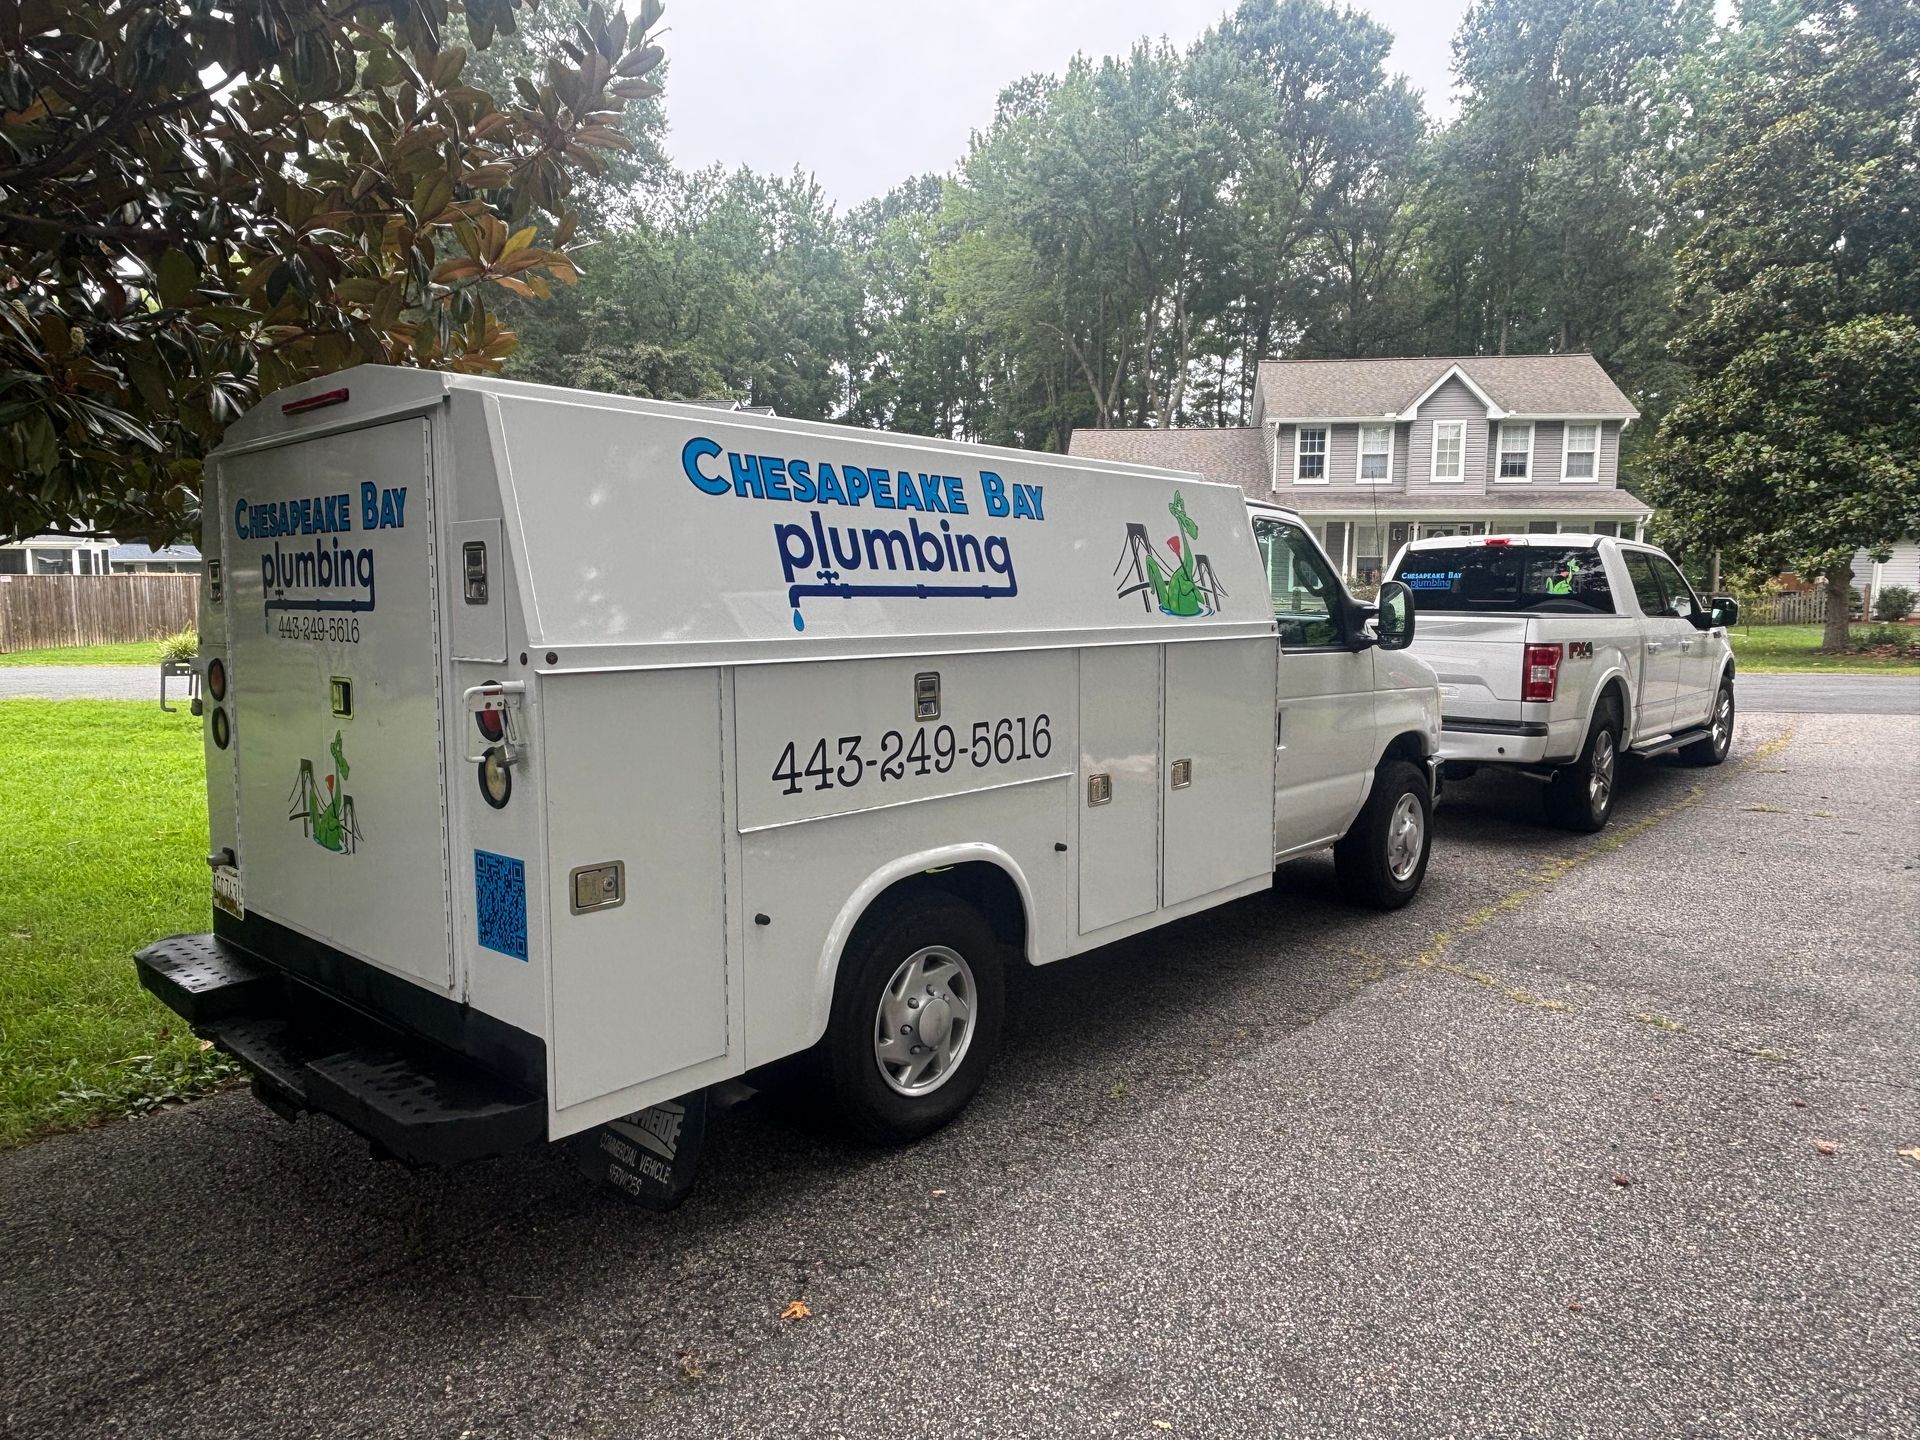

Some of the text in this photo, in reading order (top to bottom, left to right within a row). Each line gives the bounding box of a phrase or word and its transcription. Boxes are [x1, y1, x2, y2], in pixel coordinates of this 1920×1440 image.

[682, 436, 1045, 521] CHESAPEAKE BAY
[235, 480, 407, 540] CHESAPEAKE BAY
[261, 536, 375, 612] plumbing
[773, 510, 1018, 599] plumbing
[1411, 579, 1451, 590] plumbing
[278, 615, 360, 644] 443-249-5616
[1569, 641, 1593, 660] FX4
[772, 713, 1052, 796] 443-249-5616
[609, 1163, 642, 1197] SERVICES
[639, 1153, 672, 1185] VEHICLE
